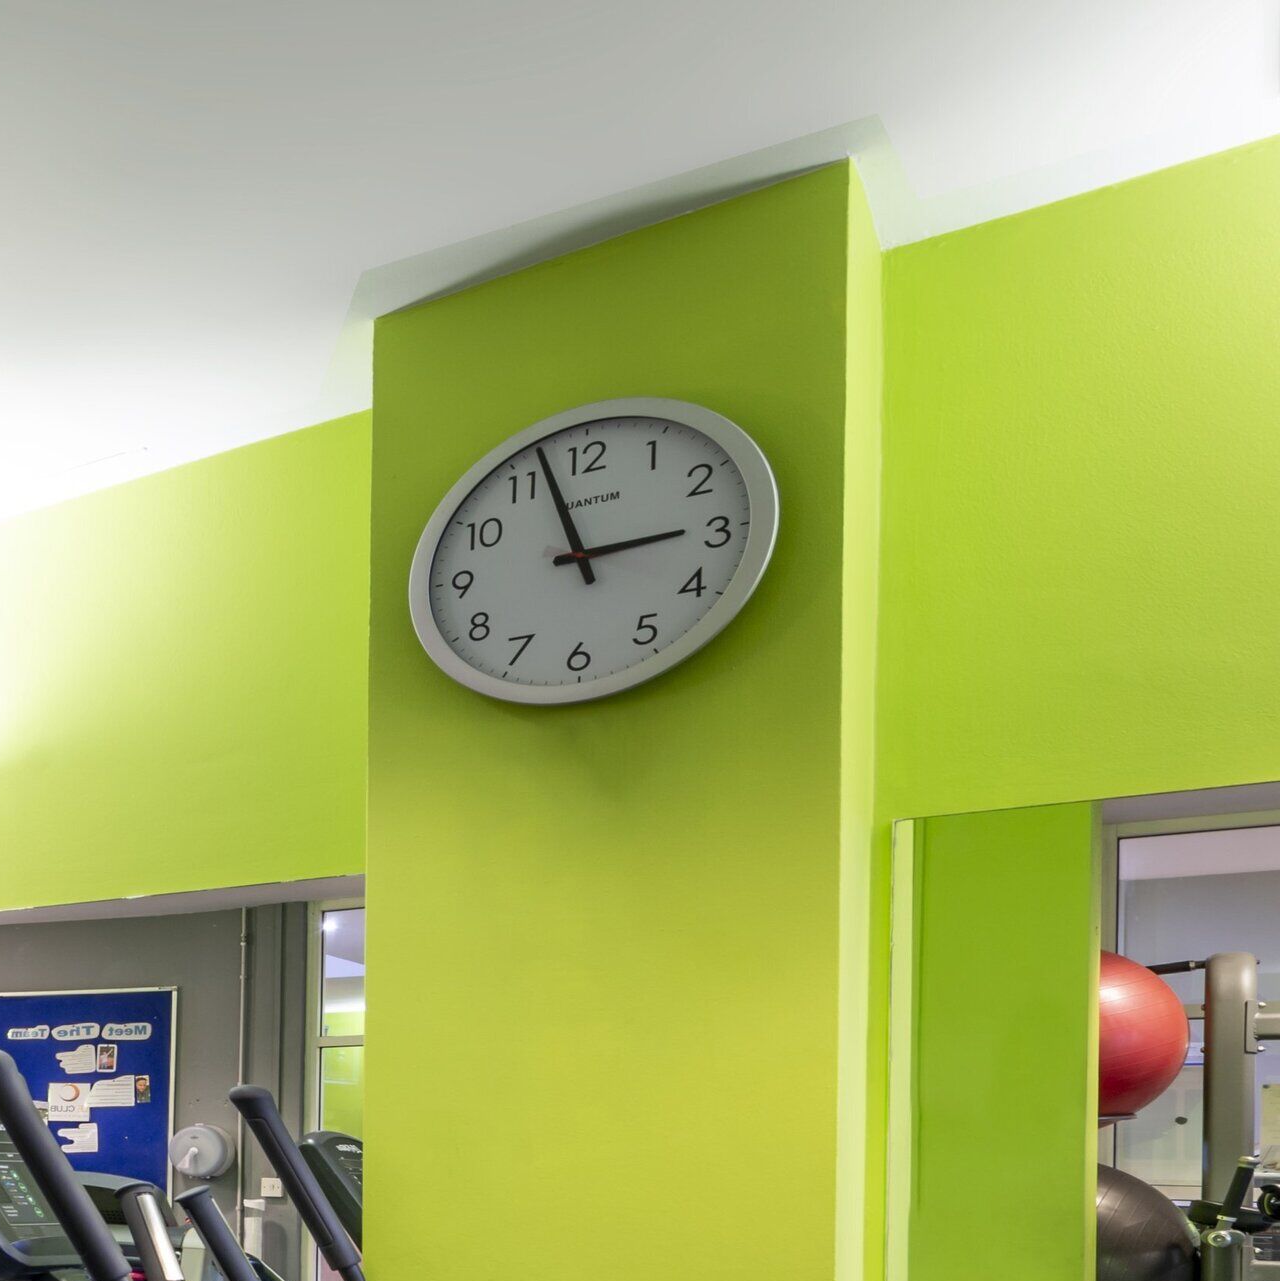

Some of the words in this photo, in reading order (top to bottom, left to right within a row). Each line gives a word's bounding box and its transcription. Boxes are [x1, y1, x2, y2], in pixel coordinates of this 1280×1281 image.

[567, 440, 608, 477] 12
[645, 439, 658, 471] 1
[507, 470, 537, 504] 11
[685, 463, 714, 499] 2
[565, 491, 621, 511] UANTUM
[466, 517, 504, 551] 10
[703, 515, 732, 549] 3
[450, 569, 475, 600] 9
[676, 565, 708, 599] 4
[468, 611, 491, 642] 8
[631, 612, 659, 646] 5
[507, 632, 536, 667] 7
[565, 641, 592, 673] 6
